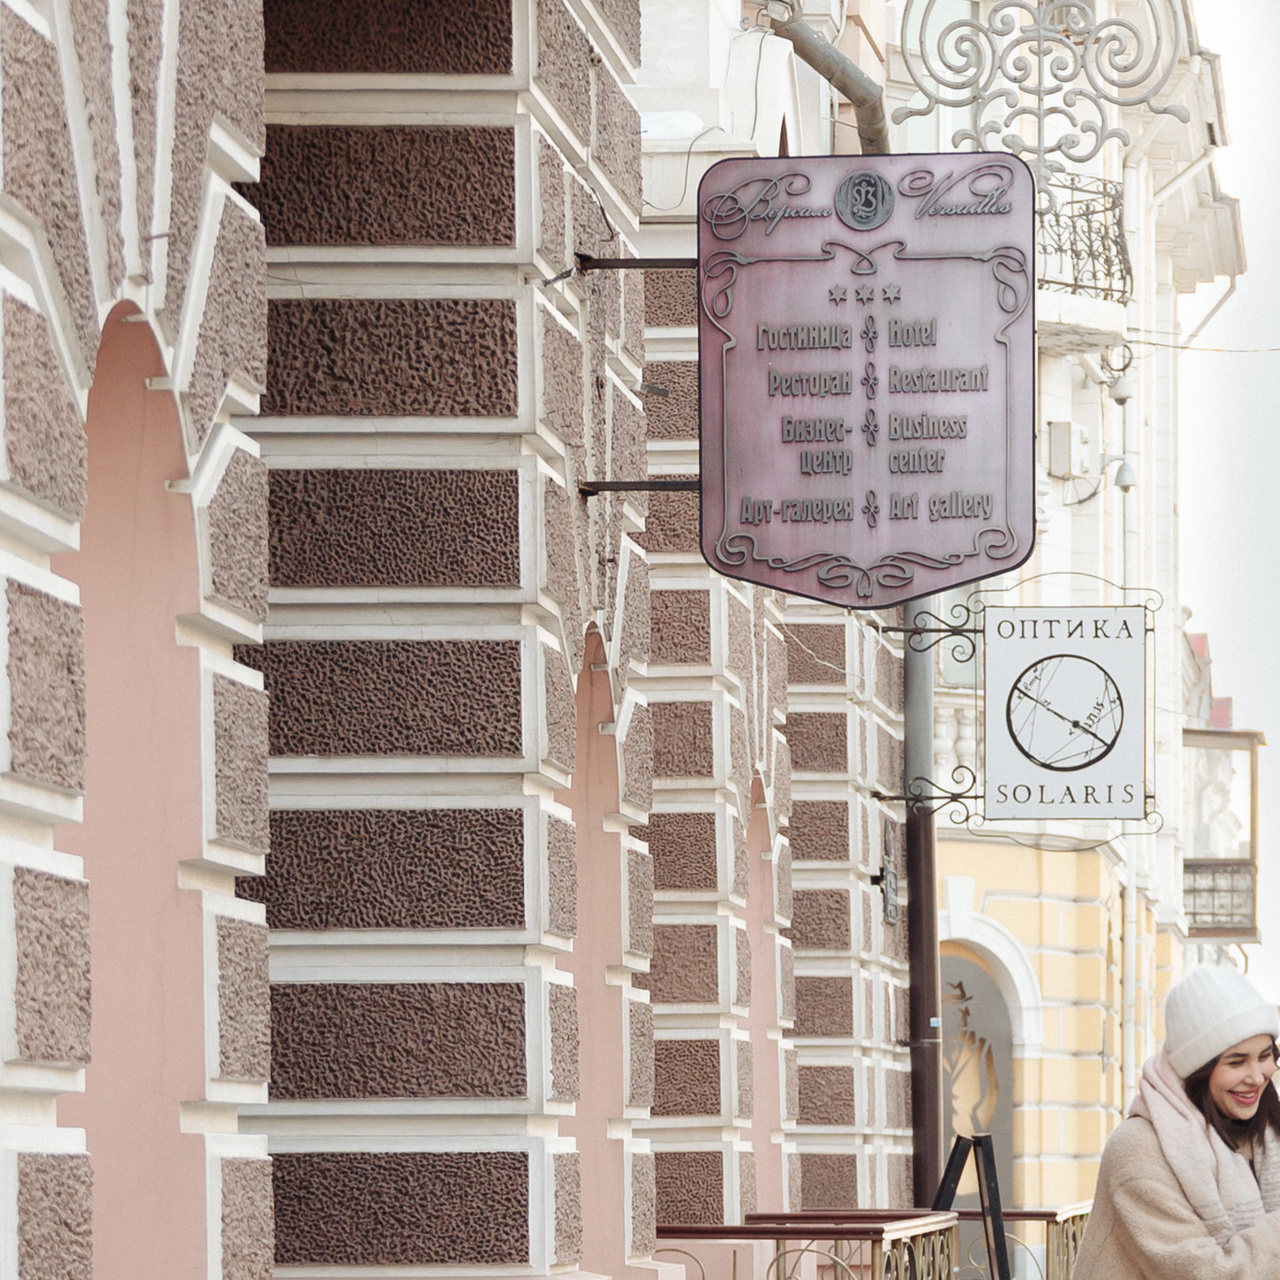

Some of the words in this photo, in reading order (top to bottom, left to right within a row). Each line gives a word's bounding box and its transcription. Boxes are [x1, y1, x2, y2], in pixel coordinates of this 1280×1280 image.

[897, 162, 1014, 220] Versailles
[757, 322, 852, 351] Гостиница
[888, 320, 937, 346] Hotel
[769, 369, 852, 397] Ресторан
[888, 365, 988, 392] Restaurant
[782, 415, 853, 443] Бизнес-
[888, 413, 967, 440] Business
[801, 449, 852, 475] центр
[888, 448, 945, 474] center
[740, 496, 853, 525] Арт-галерея
[888, 492, 919, 520] Art
[929, 491, 993, 520] gallery
[997, 619, 1133, 639] ОПТИКА
[996, 784, 1134, 805] SOLARIS
